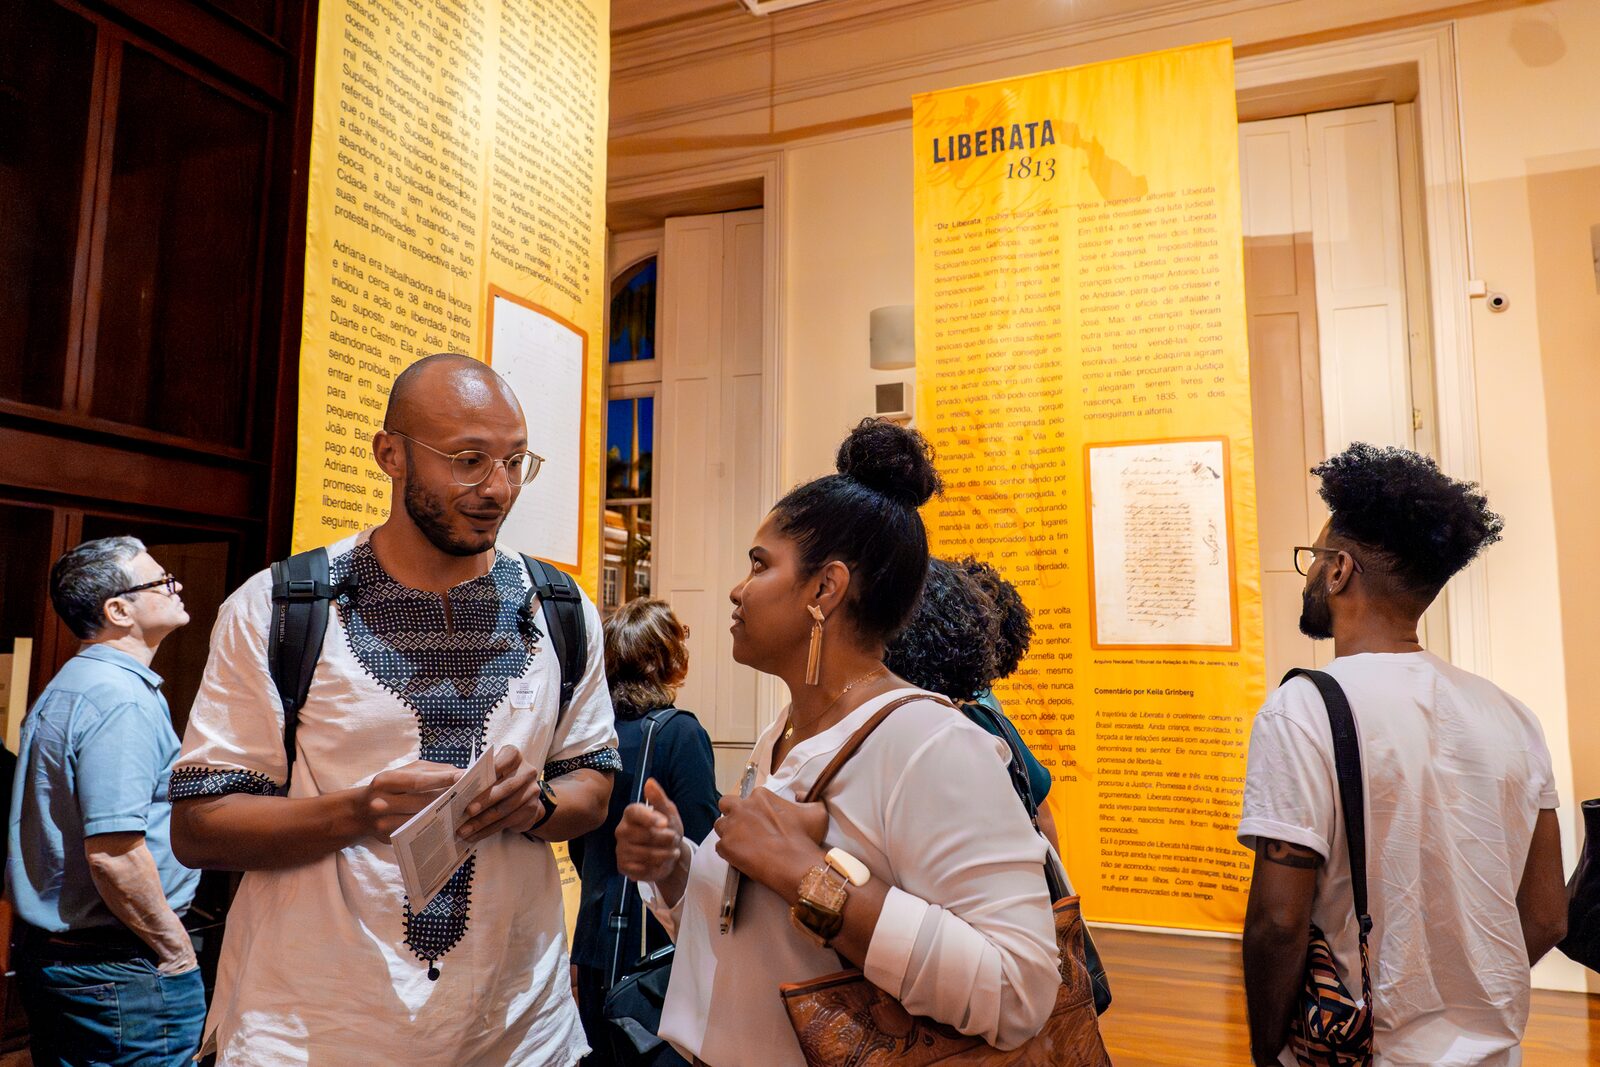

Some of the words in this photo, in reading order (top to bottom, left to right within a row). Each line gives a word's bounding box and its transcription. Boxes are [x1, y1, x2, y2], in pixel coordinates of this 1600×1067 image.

[933, 119, 1055, 164] LIBERATA
[1007, 156, 1056, 182] 1813
[1093, 686, 1132, 694] Comentário
[1146, 687, 1163, 695] Keila
[1164, 687, 1194, 698] Grinberg
